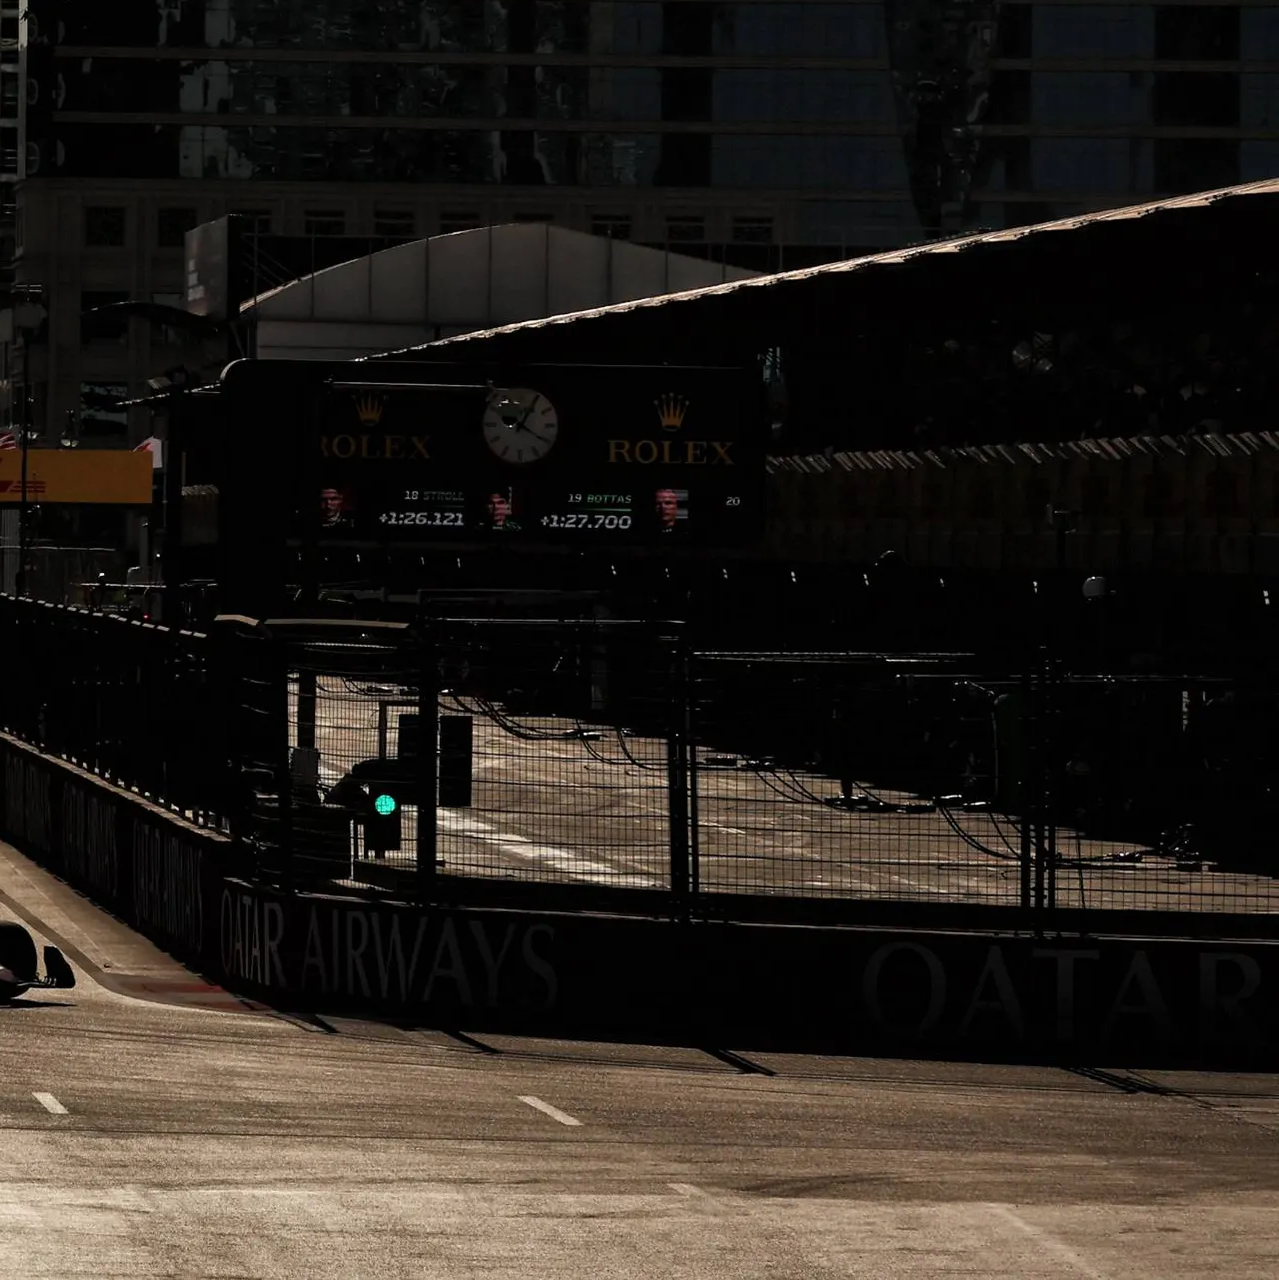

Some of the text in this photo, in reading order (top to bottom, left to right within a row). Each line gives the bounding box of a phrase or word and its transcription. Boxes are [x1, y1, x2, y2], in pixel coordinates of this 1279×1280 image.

[607, 439, 734, 465] ROLEX
[404, 490, 464, 501] 18 STROLL
[567, 493, 633, 504] 19 BOTTAS
[726, 496, 741, 507] 20
[379, 512, 465, 527] +1:26.121
[541, 515, 633, 530] +1:27.700
[220, 887, 558, 1010] QATAR AIRWAYS
[860, 940, 1269, 1048] QATAR
